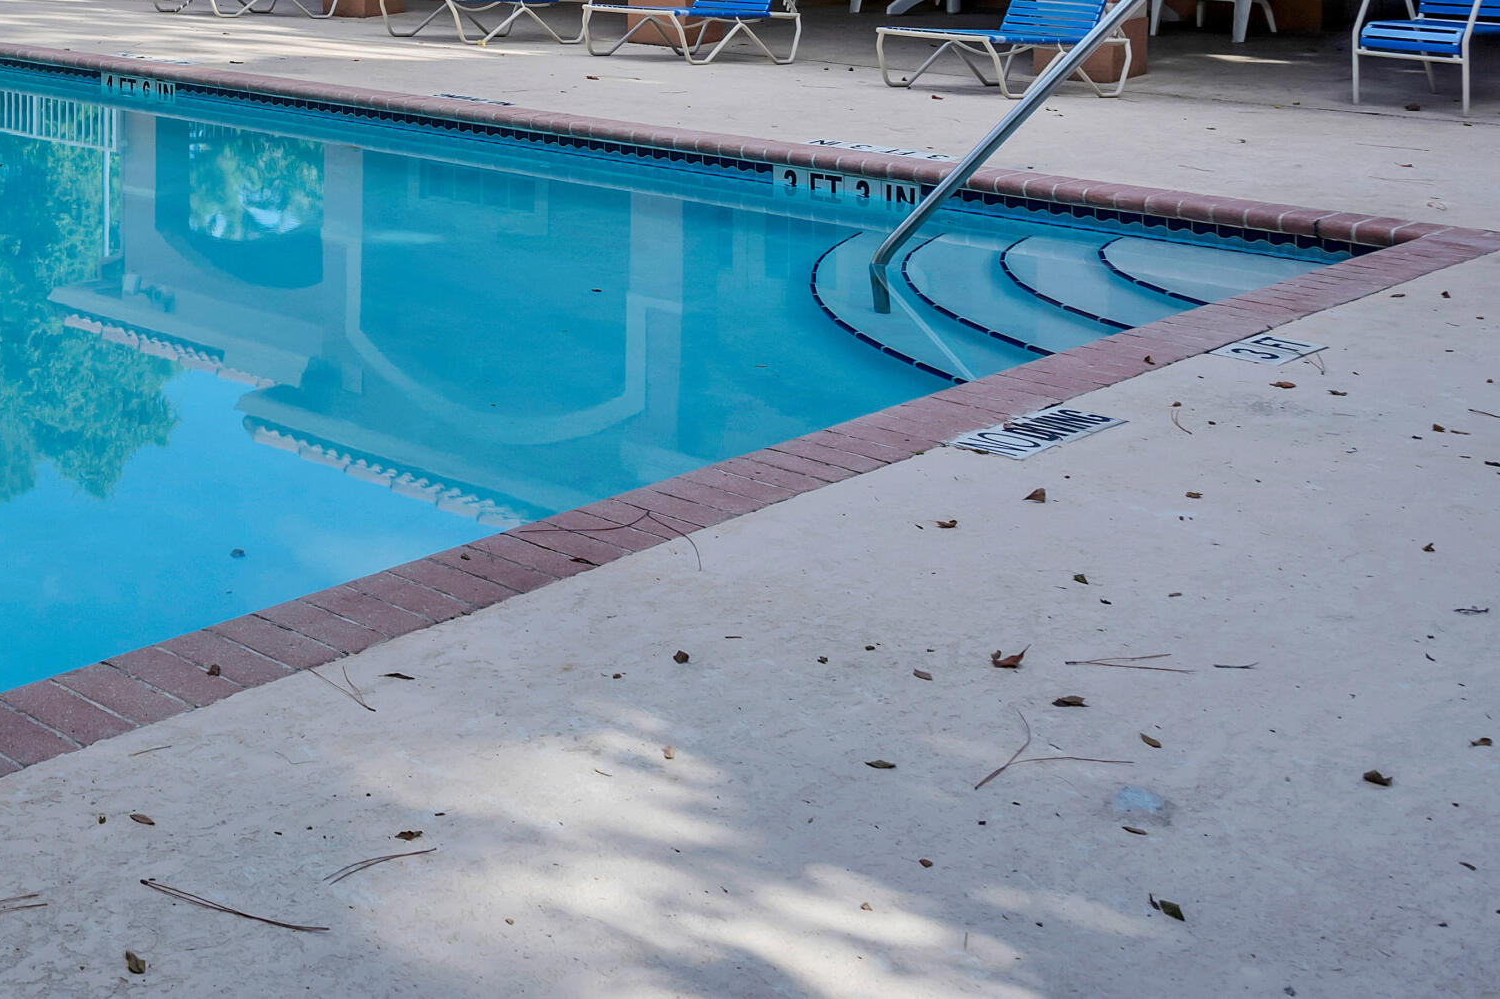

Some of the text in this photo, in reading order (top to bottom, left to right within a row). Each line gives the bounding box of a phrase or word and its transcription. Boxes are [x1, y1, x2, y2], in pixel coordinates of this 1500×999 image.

[784, 169, 916, 205] 3 FT 3 IN
[1230, 336, 1312, 360] 3 FT
[957, 409, 1114, 457] NO DIVING
